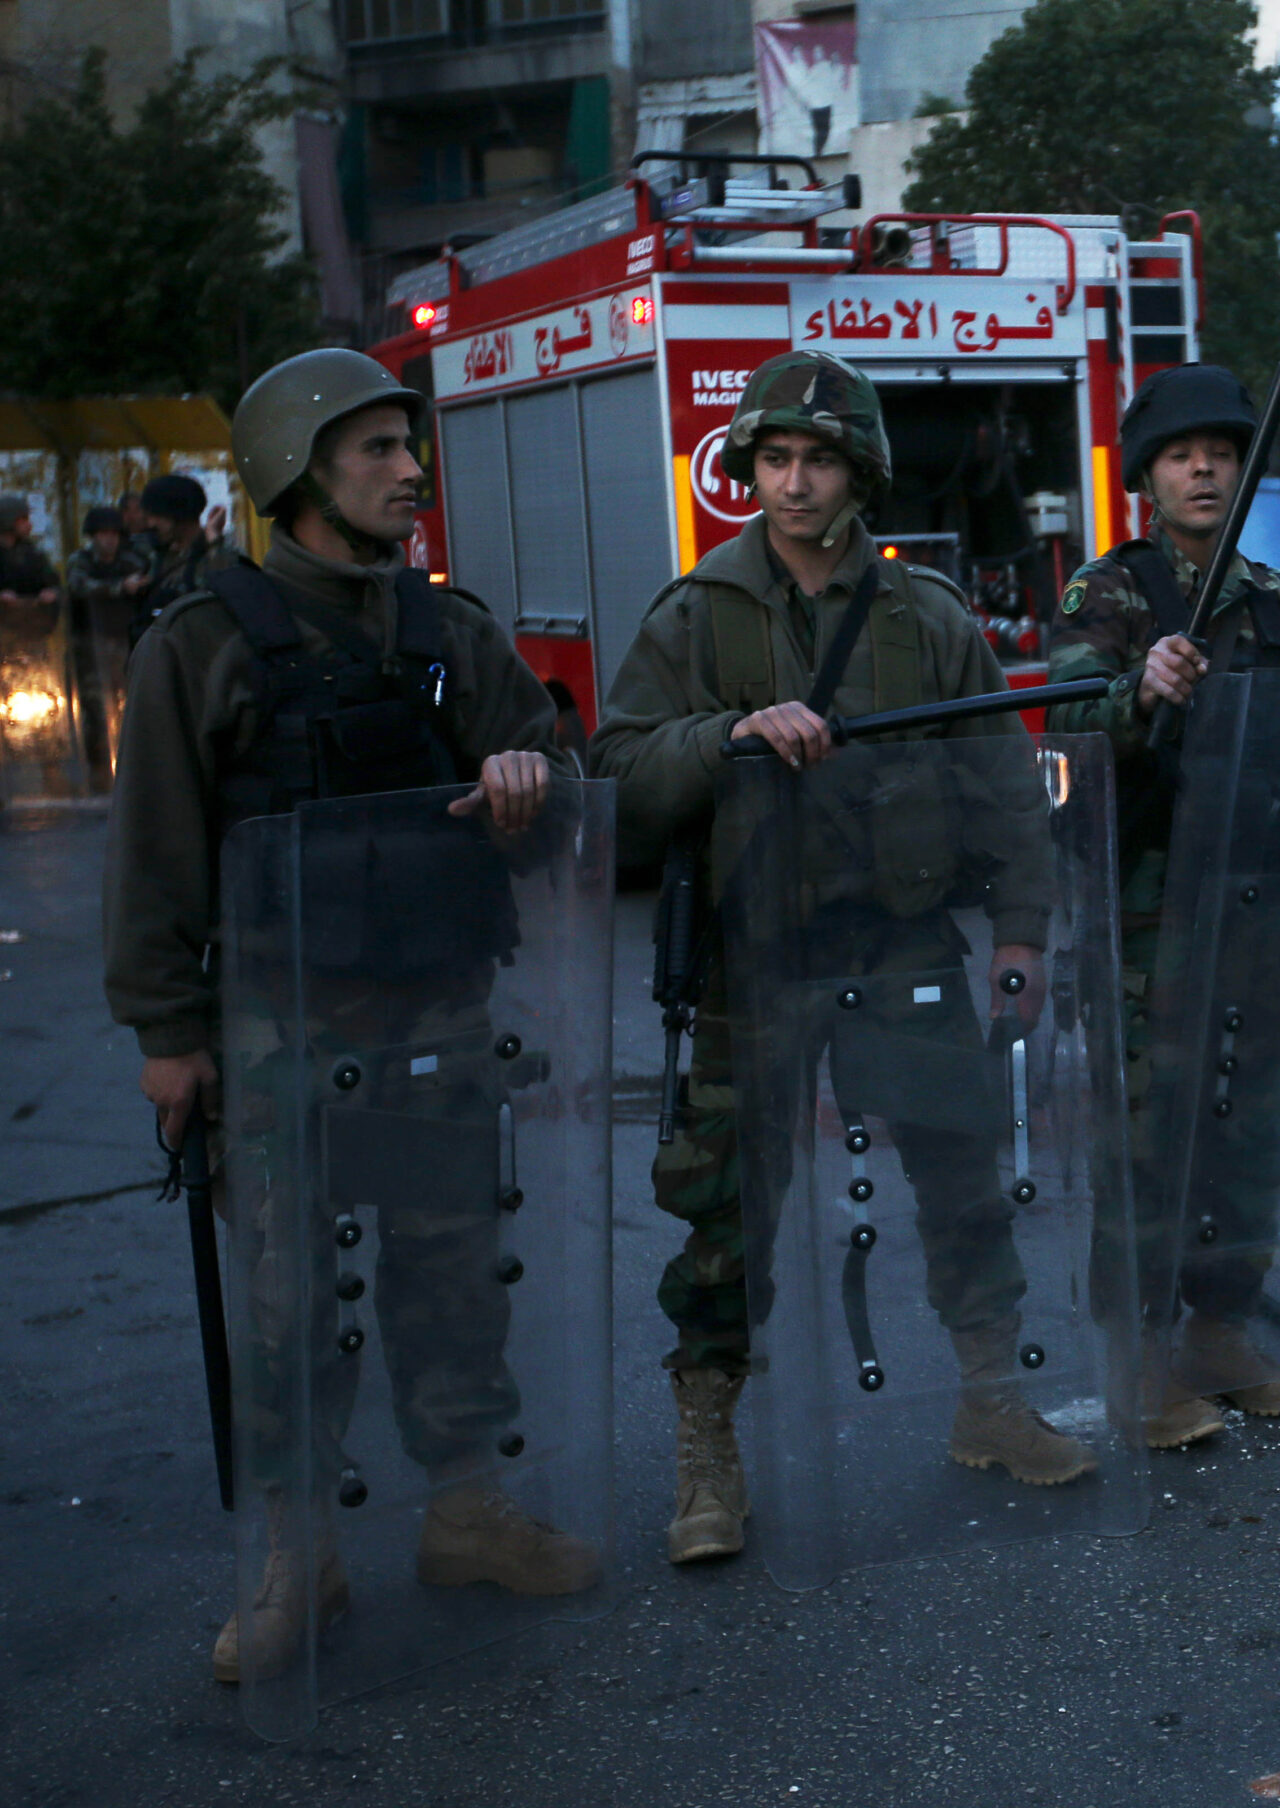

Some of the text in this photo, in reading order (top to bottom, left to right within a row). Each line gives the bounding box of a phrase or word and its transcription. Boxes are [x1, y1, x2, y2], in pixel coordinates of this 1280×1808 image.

[627, 233, 655, 260] IVECO
[534, 305, 593, 377] فوج
[952, 293, 1054, 353] فوج
[692, 370, 755, 389] IVEC
